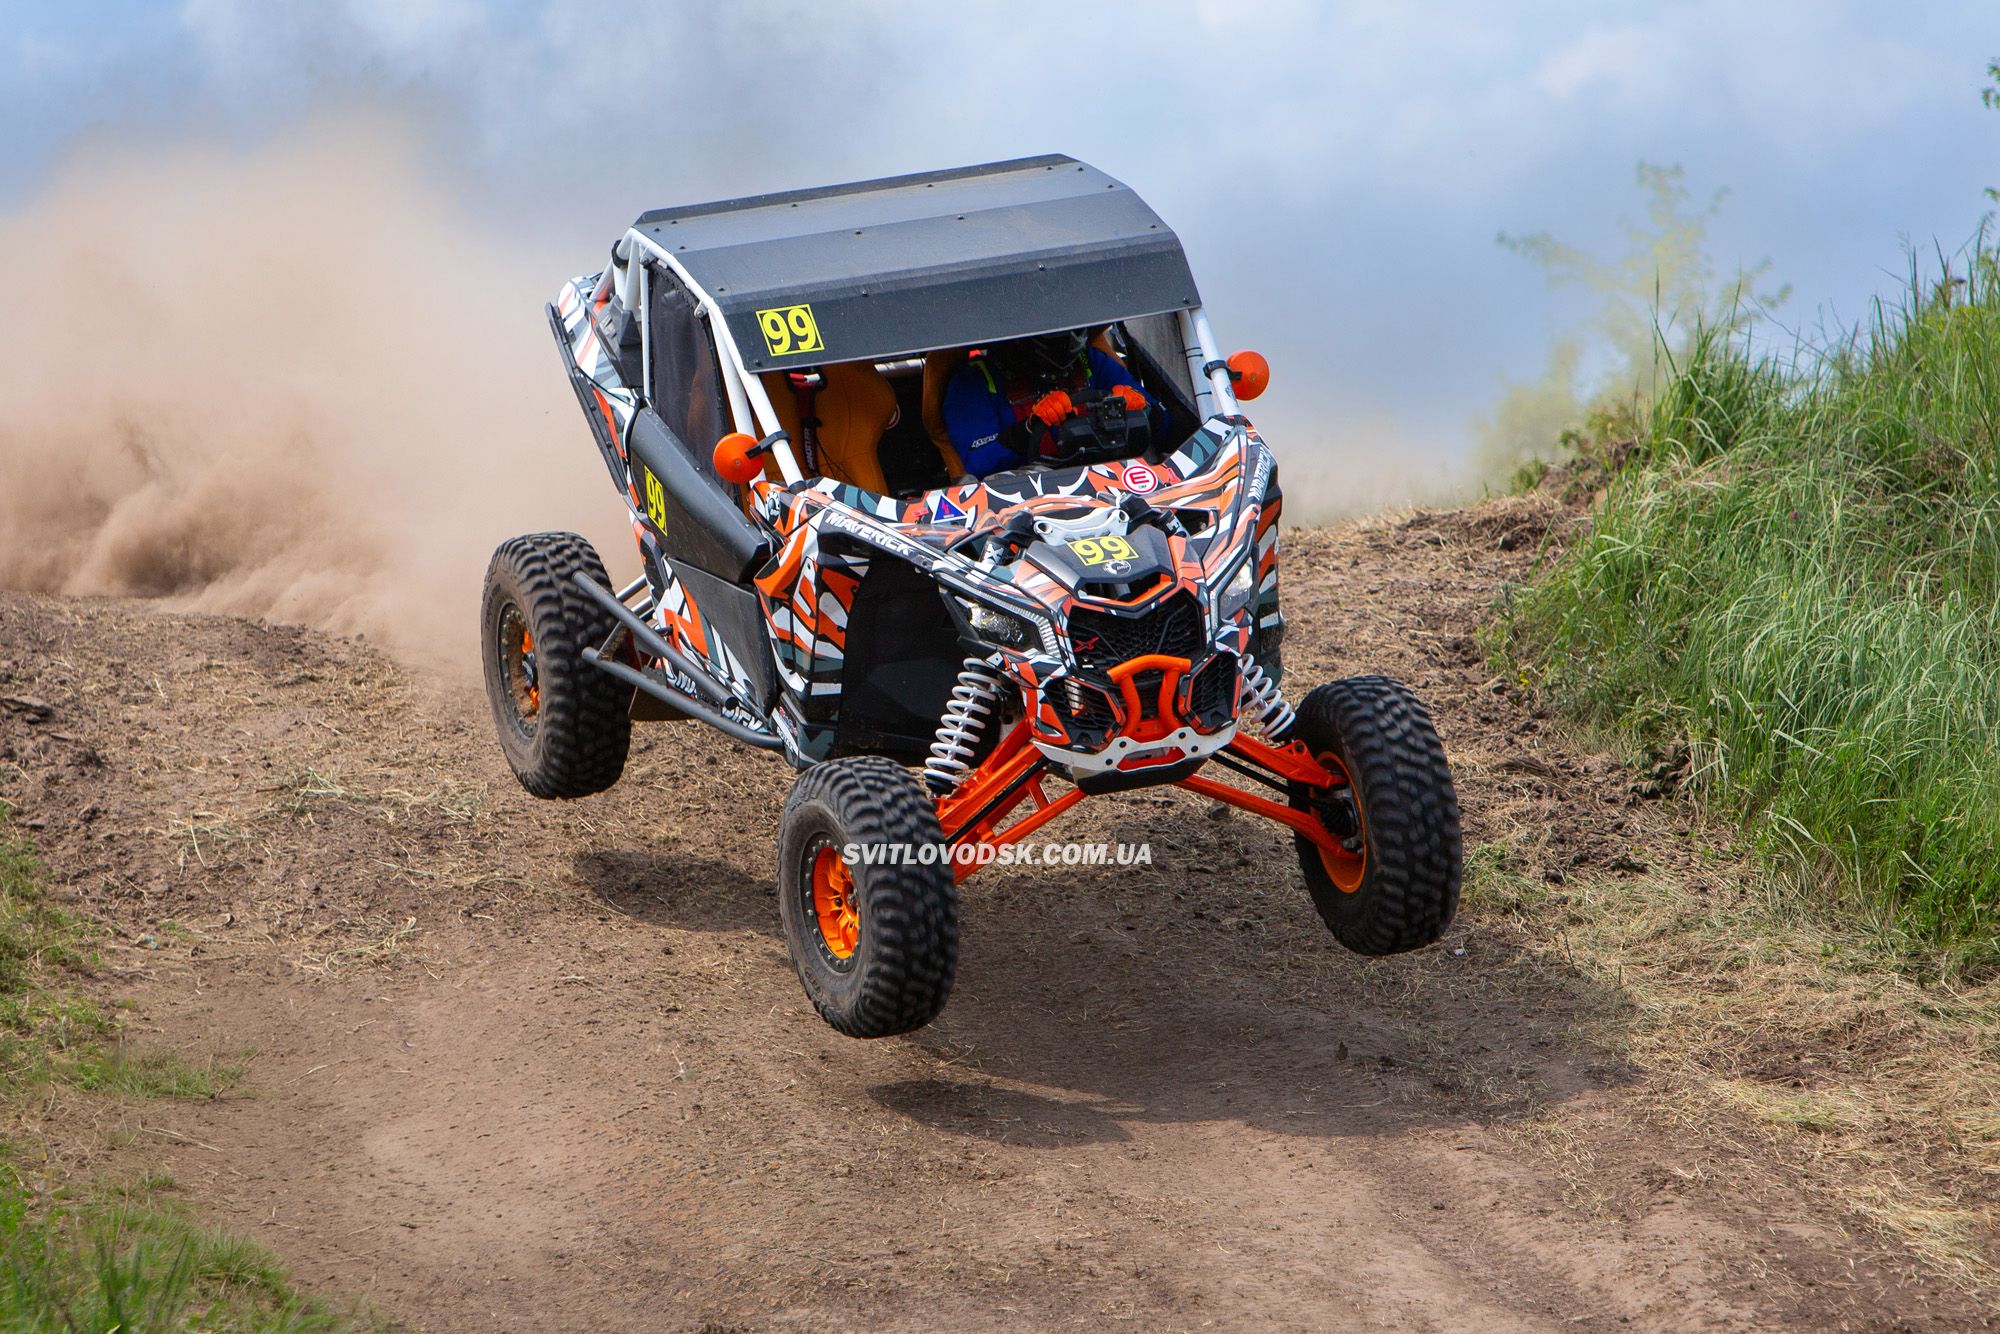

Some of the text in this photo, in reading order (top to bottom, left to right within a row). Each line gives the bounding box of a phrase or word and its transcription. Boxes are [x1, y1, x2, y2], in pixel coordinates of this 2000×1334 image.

[762, 308, 816, 353] 99
[1247, 446, 1271, 501] MAVERICK
[646, 471, 666, 529] 99
[825, 512, 915, 557] MAVERICK
[1073, 536, 1130, 564] 99
